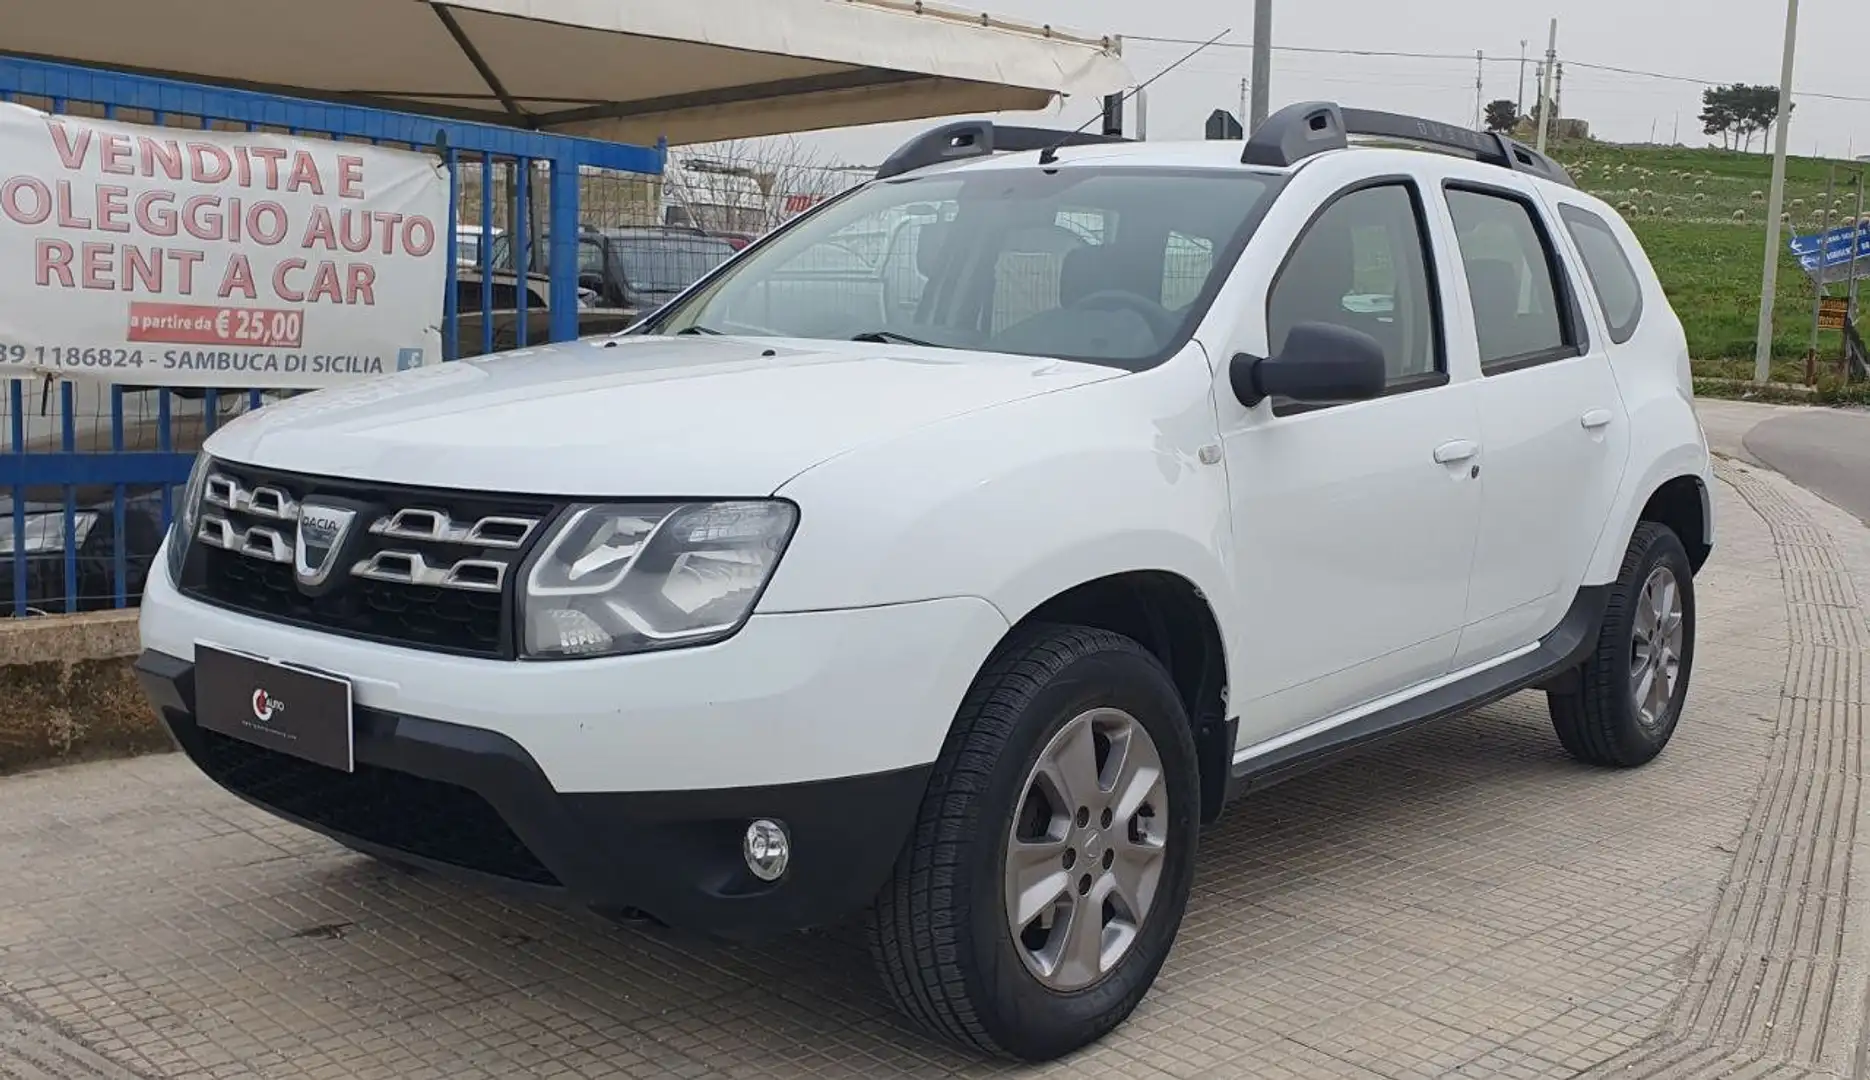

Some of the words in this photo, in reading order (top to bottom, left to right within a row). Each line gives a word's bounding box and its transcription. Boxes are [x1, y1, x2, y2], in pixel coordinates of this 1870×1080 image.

[49, 121, 324, 196] VENDITA
[338, 155, 364, 199] E
[1, 174, 288, 246] OLEGGIO
[301, 205, 436, 257] AUTO
[34, 237, 205, 296] RENT
[217, 252, 258, 300] A
[271, 258, 376, 306] CAR
[130, 315, 140, 328] a
[142, 314, 193, 332] partire
[194, 317, 212, 330] da
[215, 309, 231, 339] €
[235, 311, 300, 343] 25,00
[35, 345, 144, 369] 1186824
[163, 350, 279, 373] SAMBUCA
[284, 354, 307, 373] DI
[312, 355, 384, 374] SICILIA
[302, 515, 338, 531] DACIA
